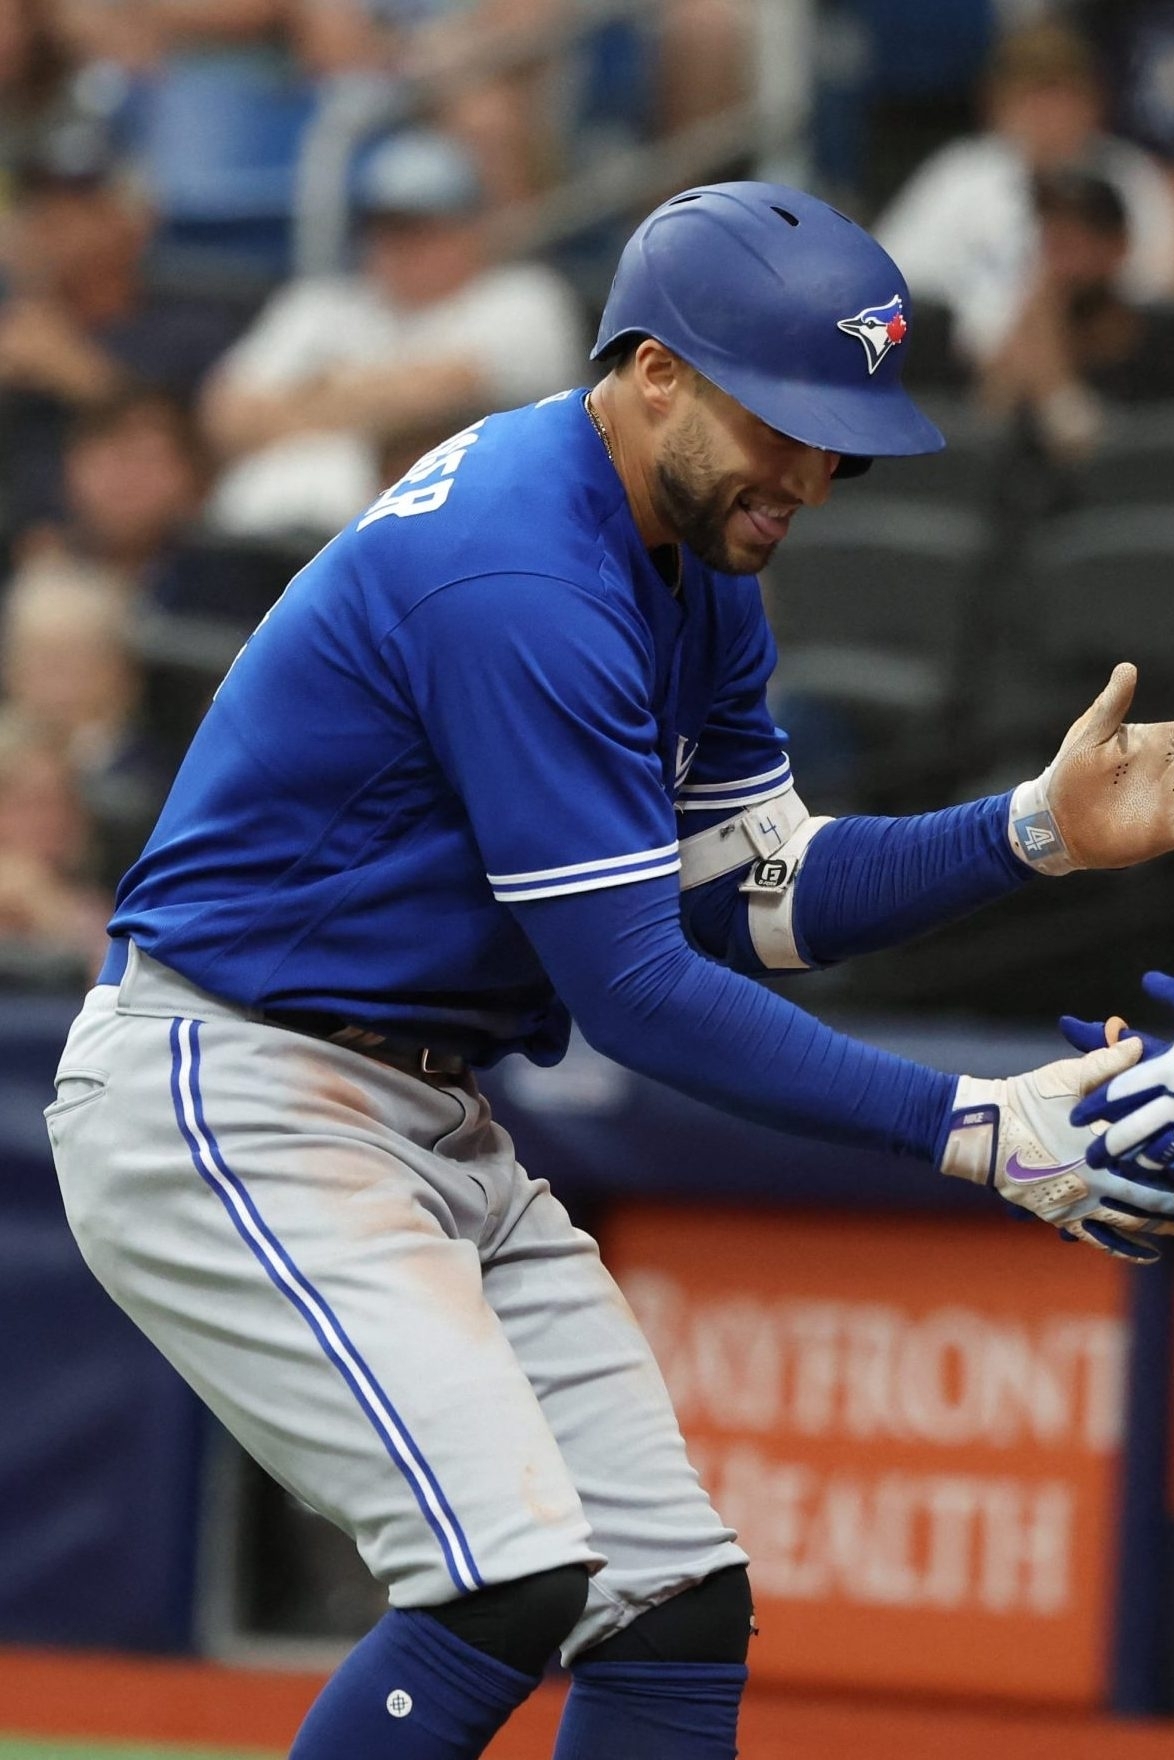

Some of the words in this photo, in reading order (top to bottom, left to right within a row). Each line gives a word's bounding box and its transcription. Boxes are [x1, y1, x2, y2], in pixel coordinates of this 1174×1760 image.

[759, 816, 782, 845] 4
[1024, 826, 1056, 852] 4
[963, 1112, 985, 1125] NIKE
